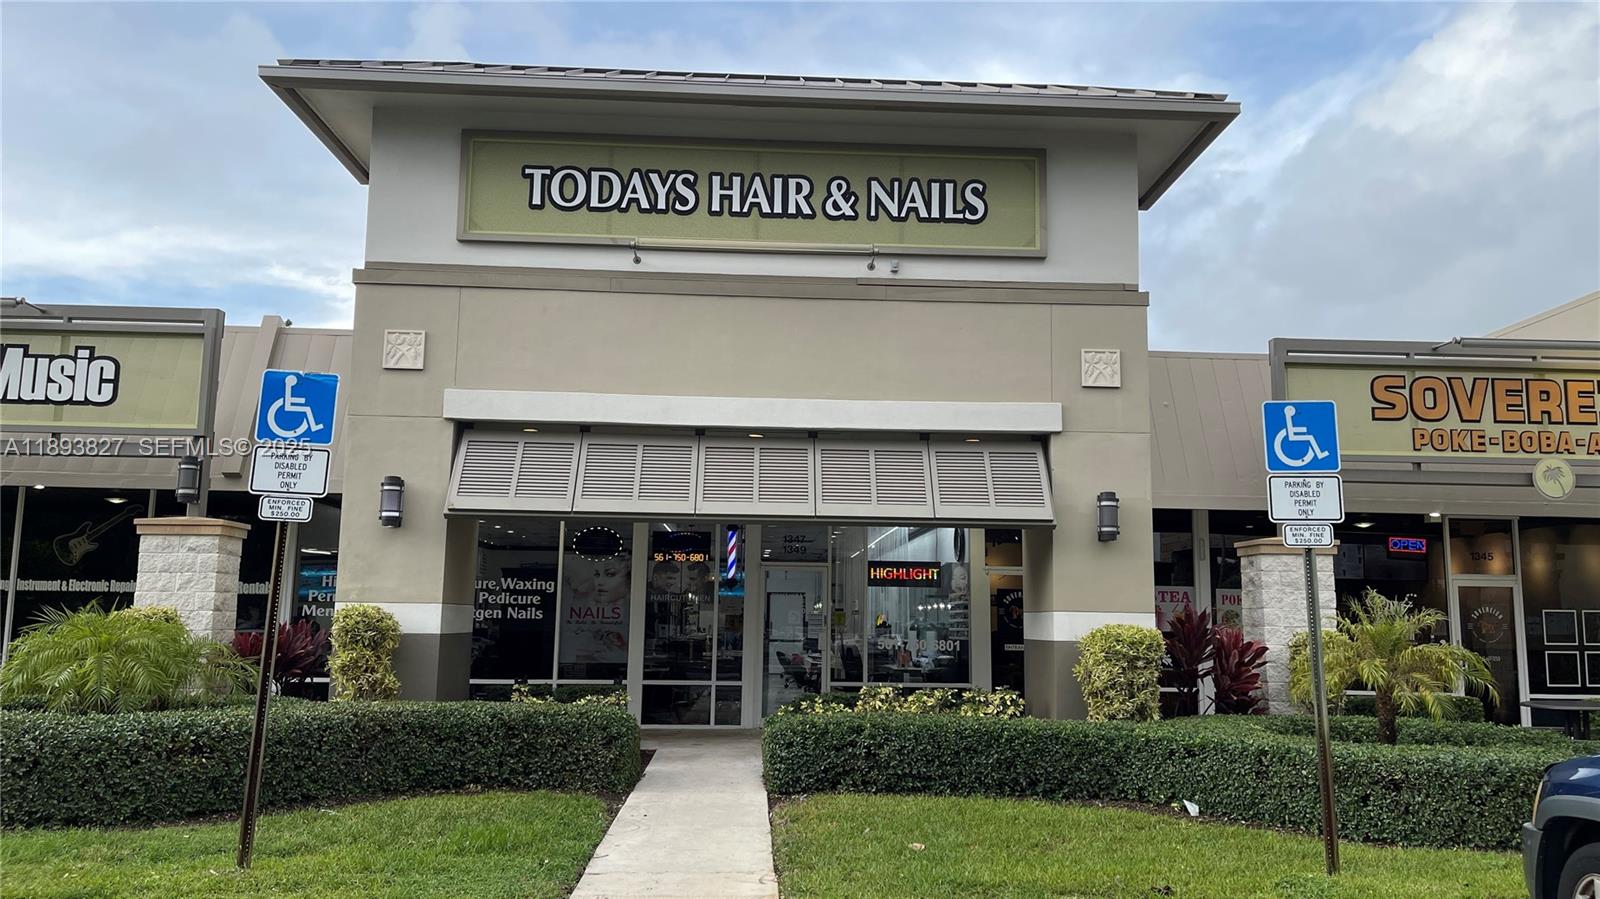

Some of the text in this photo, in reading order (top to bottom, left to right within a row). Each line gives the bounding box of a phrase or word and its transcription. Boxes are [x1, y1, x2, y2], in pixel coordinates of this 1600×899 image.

[523, 165, 989, 224] TODAYS HAIR & NAILS
[1370, 375, 1600, 426] SOVERE
[270, 452, 313, 462] PARKING BY
[274, 462, 307, 471] DISABLED
[277, 471, 302, 480] PERMIT
[280, 481, 297, 489] ONLY
[1294, 499, 1317, 507] PERMIT
[1391, 540, 1425, 550] OPEN
[1471, 552, 1494, 560] 1345
[870, 567, 940, 580] HIGHLIGHT
[16, 579, 61, 591] Instrument
[61, 580, 67, 592] &
[68, 579, 110, 592] Electronic
[479, 592, 541, 604] Pedicure
[1158, 591, 1192, 603] TEA
[507, 607, 544, 619] Nails
[570, 606, 621, 619] NAILS
